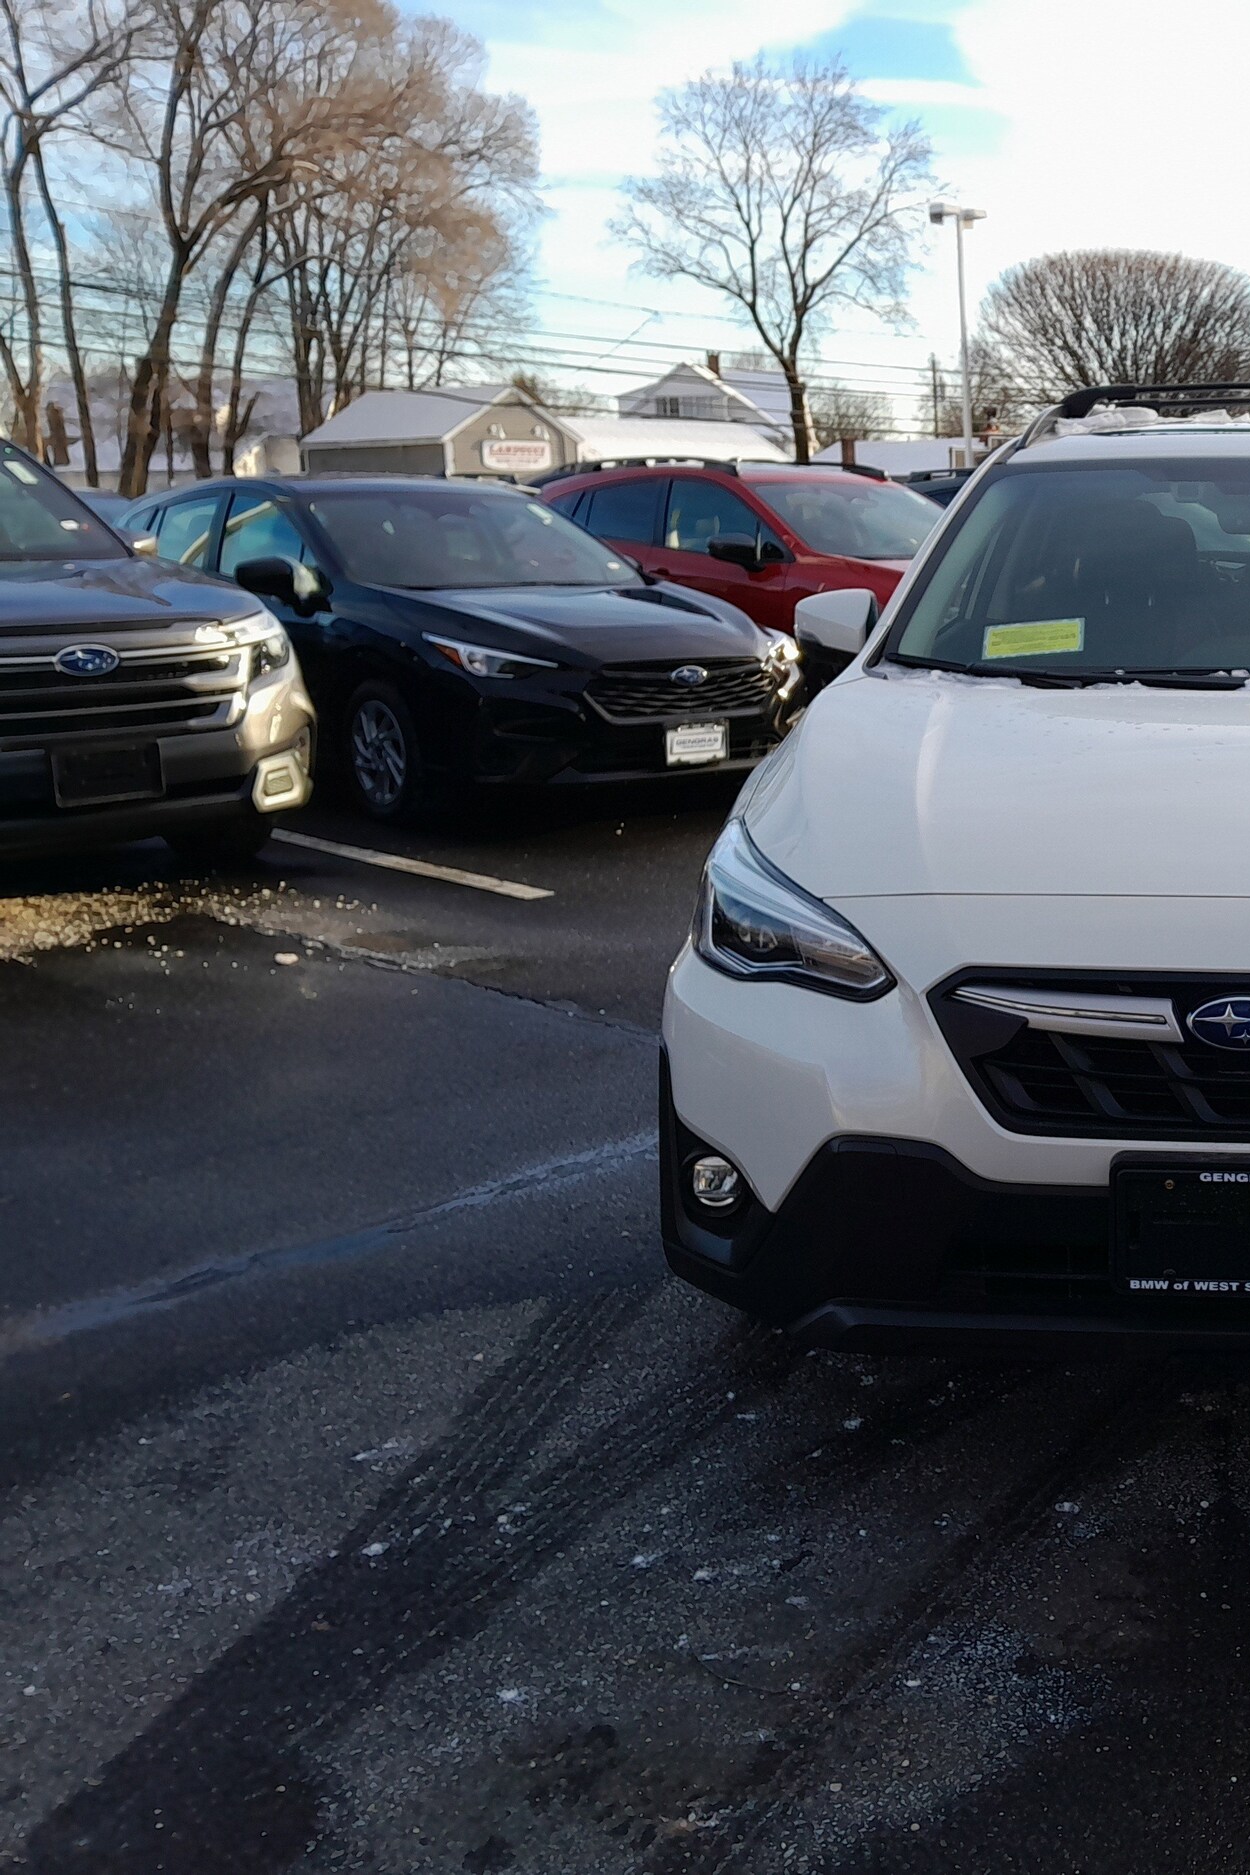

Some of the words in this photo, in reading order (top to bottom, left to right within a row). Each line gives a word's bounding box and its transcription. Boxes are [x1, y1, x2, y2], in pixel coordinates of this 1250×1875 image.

[1129, 1279, 1169, 1290] BMW
[1173, 1280, 1190, 1291] of
[1193, 1281, 1240, 1291] WEST
